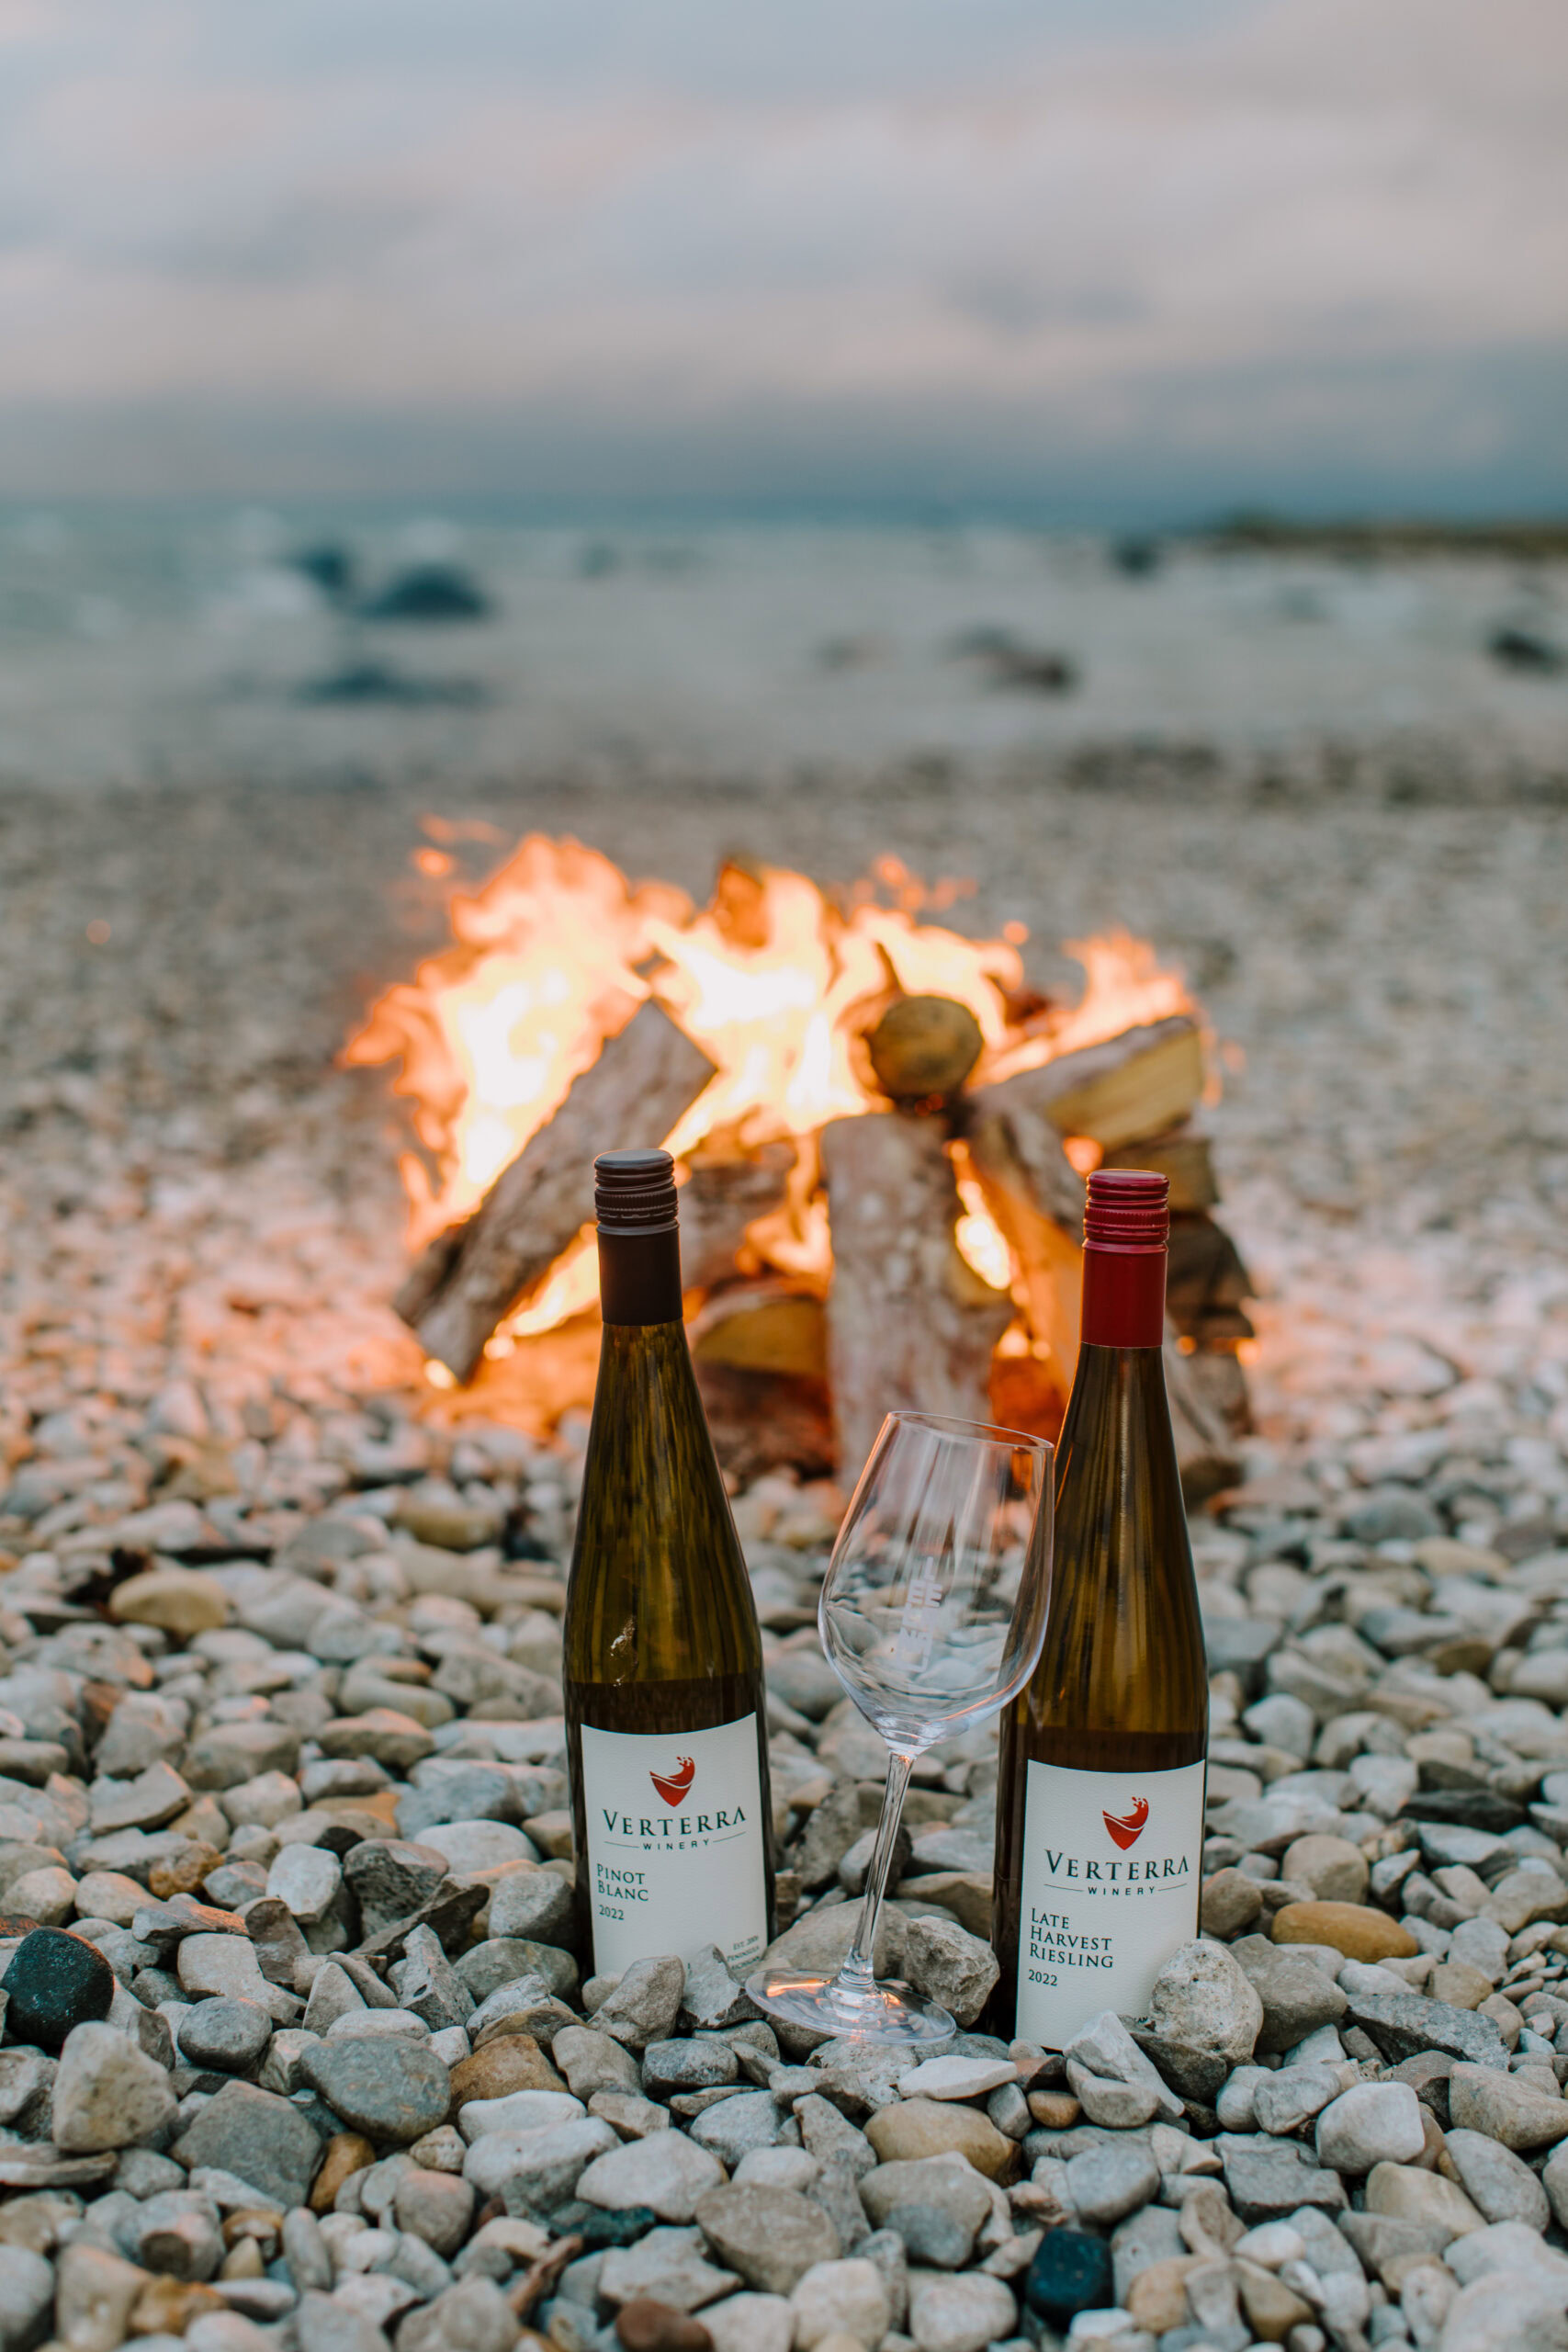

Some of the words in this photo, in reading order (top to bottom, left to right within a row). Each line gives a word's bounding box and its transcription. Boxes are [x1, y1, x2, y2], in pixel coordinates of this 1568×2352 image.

[603, 1806, 746, 1837] VERTERRA
[643, 1838, 709, 1850] WINERY
[597, 1863, 646, 1884] PINOT
[1043, 1849, 1189, 1881] VERTERRA
[597, 1880, 649, 1902] BLANC
[1088, 1885, 1155, 1896] WINERY
[599, 1905, 625, 1921] 2022
[1032, 1907, 1070, 1929] LATE
[1031, 1925, 1112, 1951] HARVEST
[1030, 1942, 1114, 1969] RIESLING
[1028, 1969, 1058, 1986] 2022
